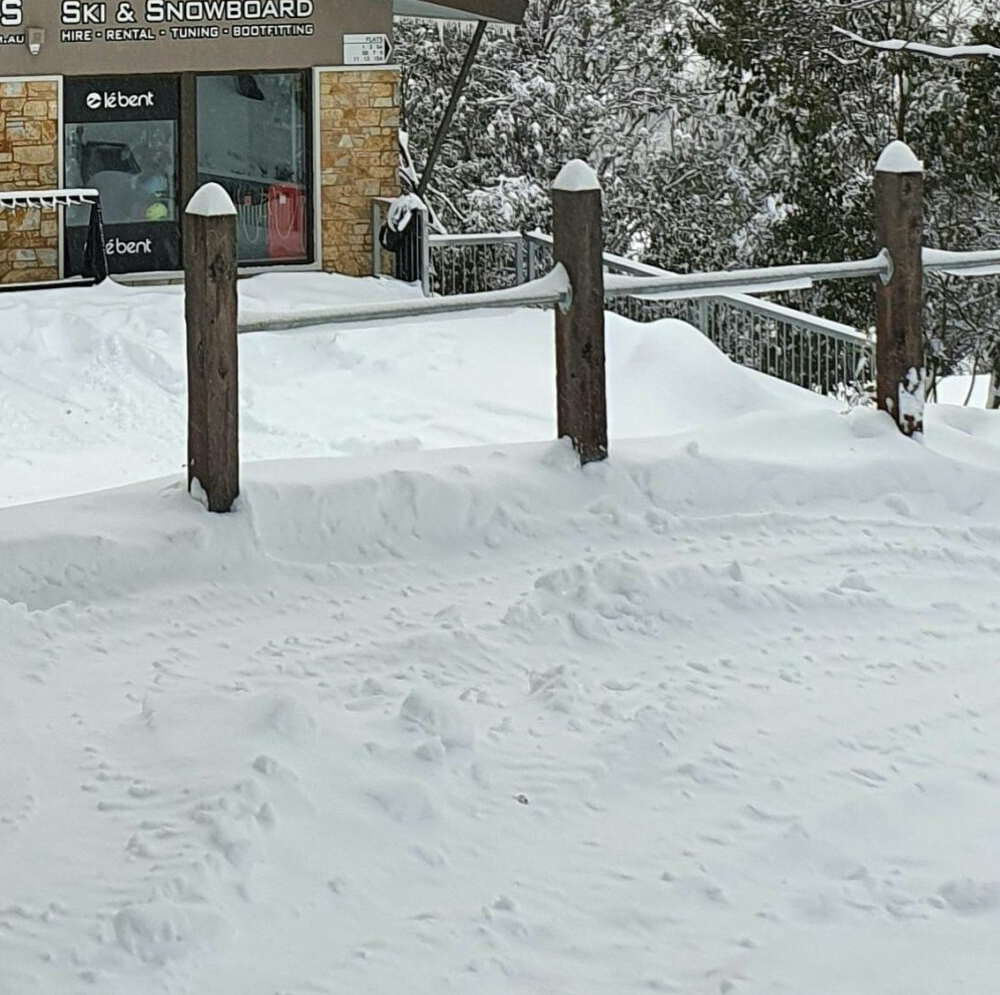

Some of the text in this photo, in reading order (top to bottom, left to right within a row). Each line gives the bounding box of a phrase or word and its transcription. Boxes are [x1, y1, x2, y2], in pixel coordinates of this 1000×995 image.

[116, 2, 137, 23] &
[61, 24, 314, 42] HIRE RENTAL TUNING BOOTFITTING
[104, 91, 154, 108] lébent
[105, 237, 152, 254] ébent
